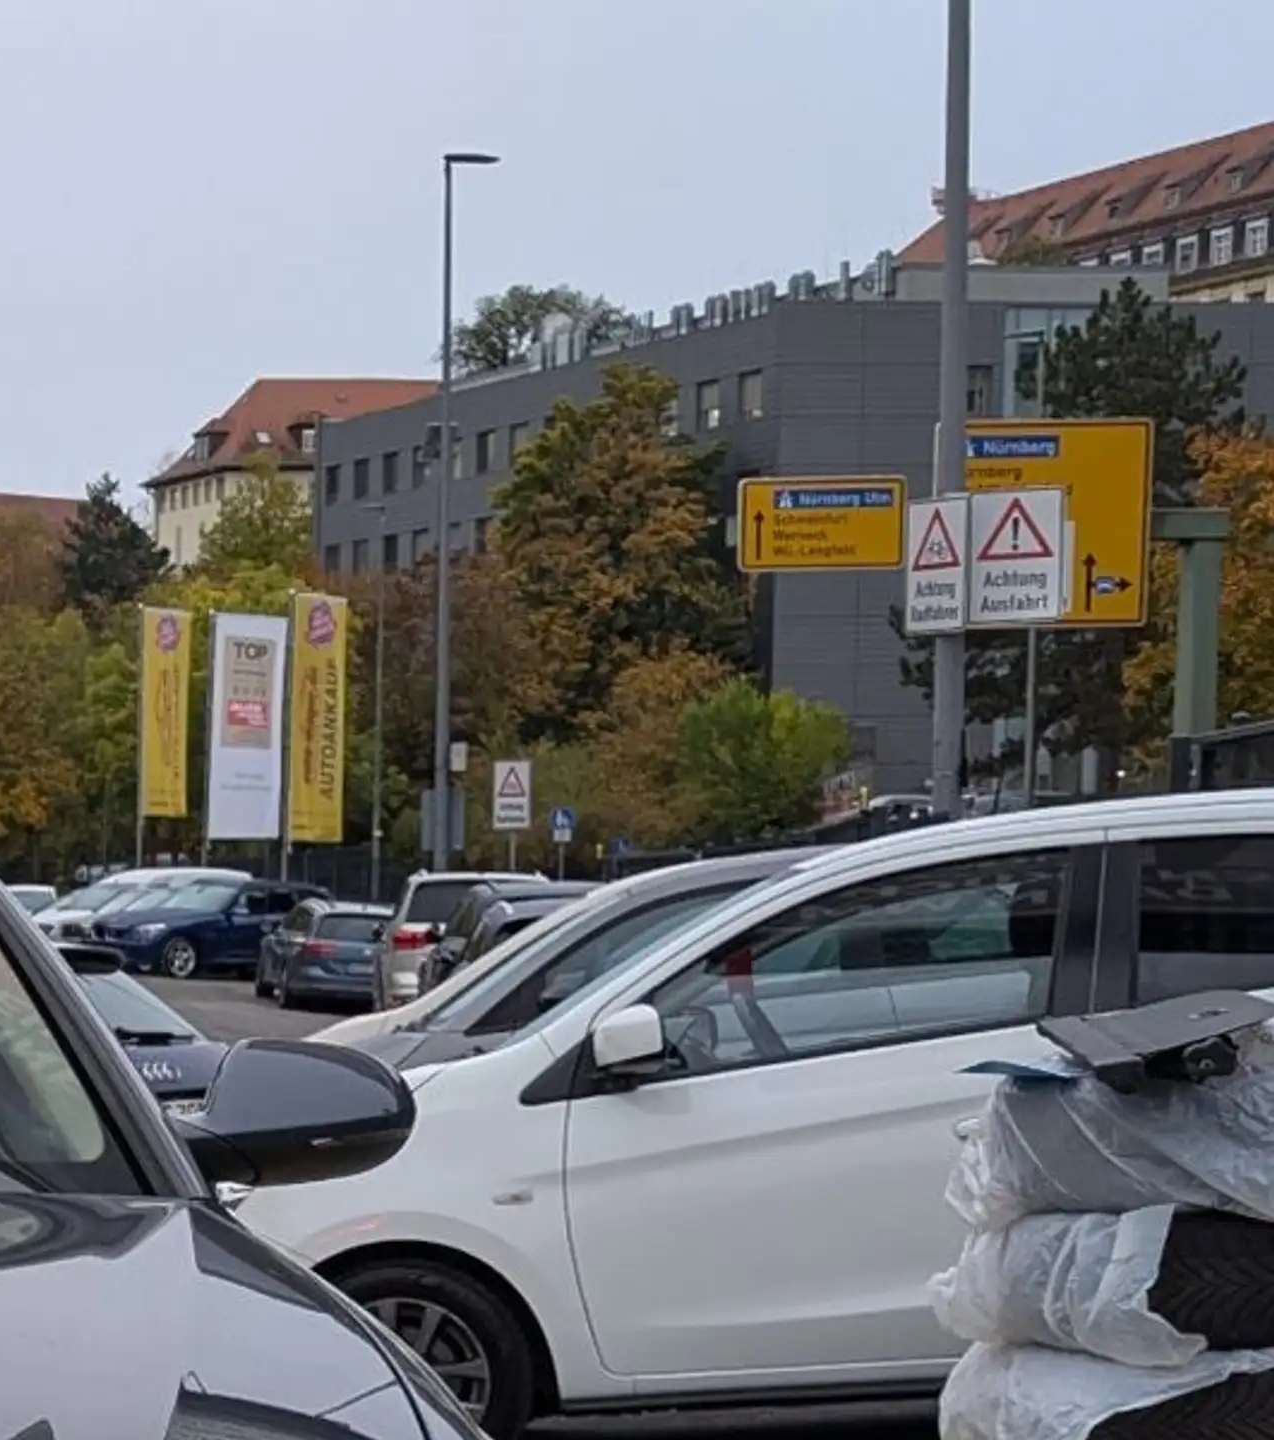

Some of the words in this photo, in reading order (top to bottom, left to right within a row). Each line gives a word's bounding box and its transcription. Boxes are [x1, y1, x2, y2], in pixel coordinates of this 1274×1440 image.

[982, 439, 1057, 457] Nürnberg
[982, 570, 1049, 590] Achtung
[979, 594, 1049, 614] Ausfahrt
[232, 641, 268, 661] TOP
[317, 656, 339, 802] AUTOANKAUF
